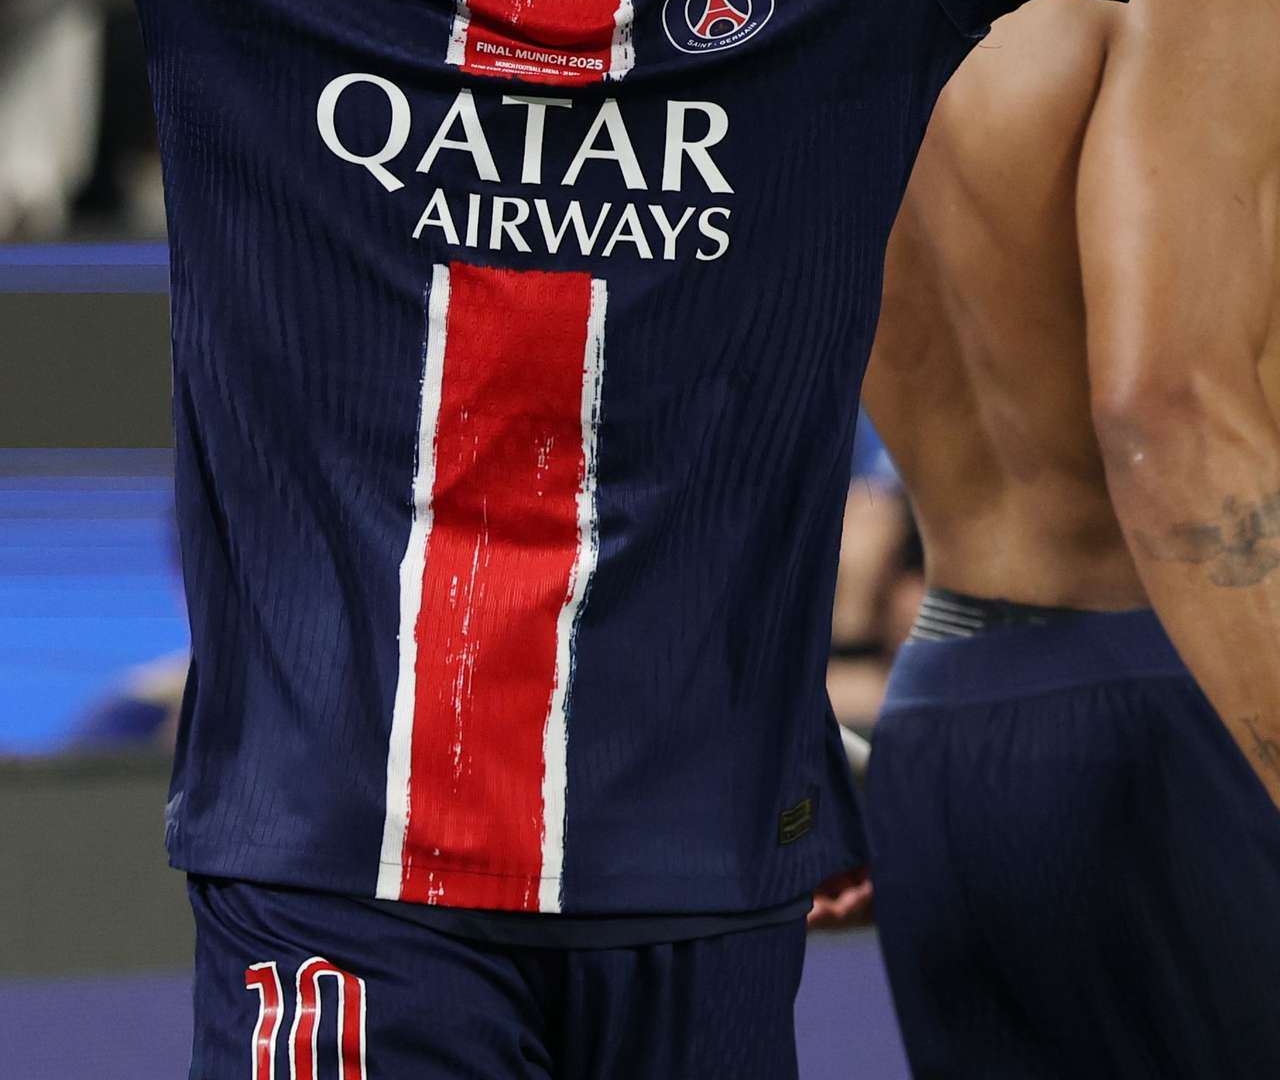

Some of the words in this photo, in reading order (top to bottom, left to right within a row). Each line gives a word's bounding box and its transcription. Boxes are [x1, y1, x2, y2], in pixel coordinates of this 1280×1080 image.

[476, 41, 513, 57] FINAL
[514, 49, 567, 66] MUNICH
[568, 56, 604, 70] 2025
[317, 72, 735, 194] QATAR
[412, 187, 731, 261] AIRWAYS
[244, 956, 367, 1080] 10
